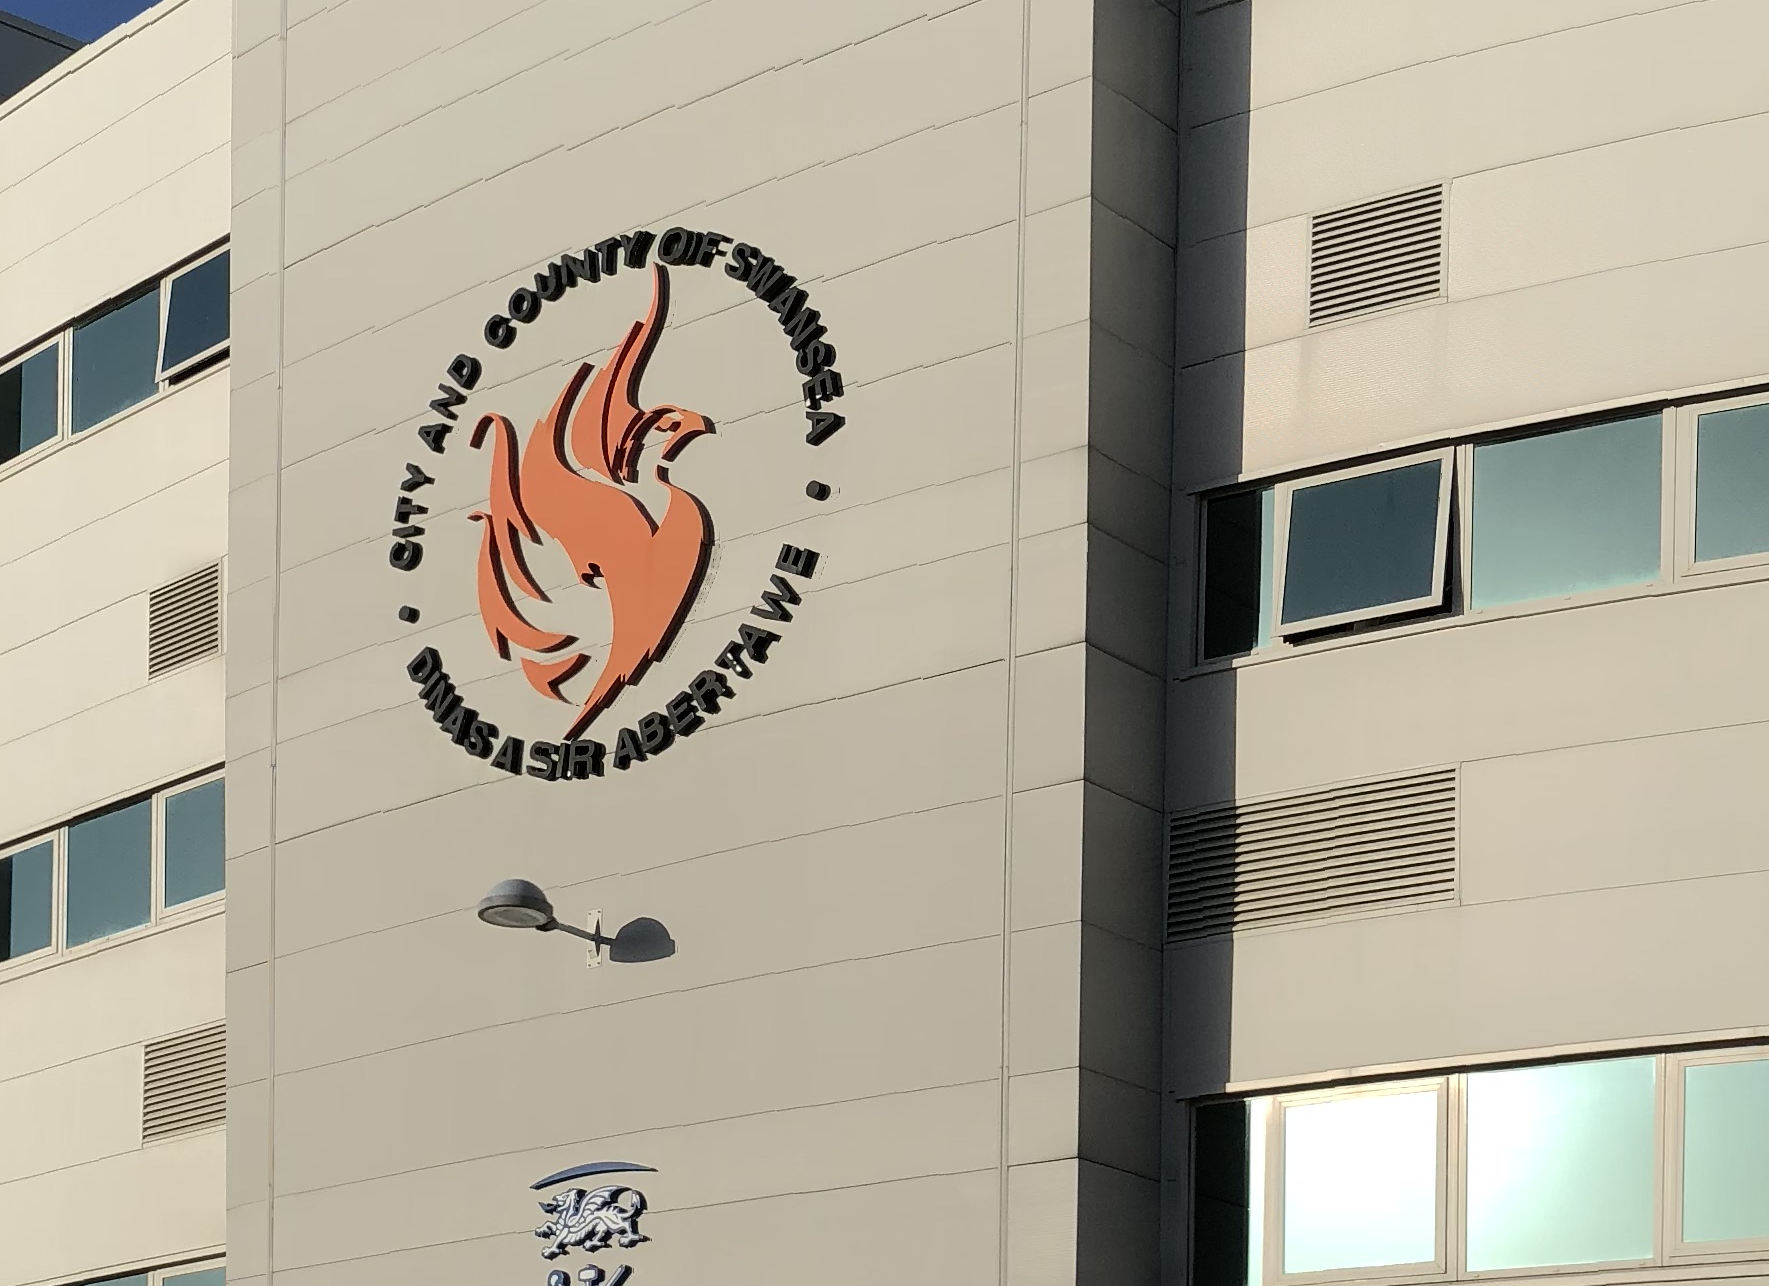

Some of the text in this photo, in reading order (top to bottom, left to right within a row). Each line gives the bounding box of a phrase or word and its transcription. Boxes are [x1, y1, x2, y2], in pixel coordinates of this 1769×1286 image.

[389, 227, 845, 571] CITY AND COUNTY OF SWANSEA
[407, 543, 820, 782] DINAS A SIR ABERTAWE
